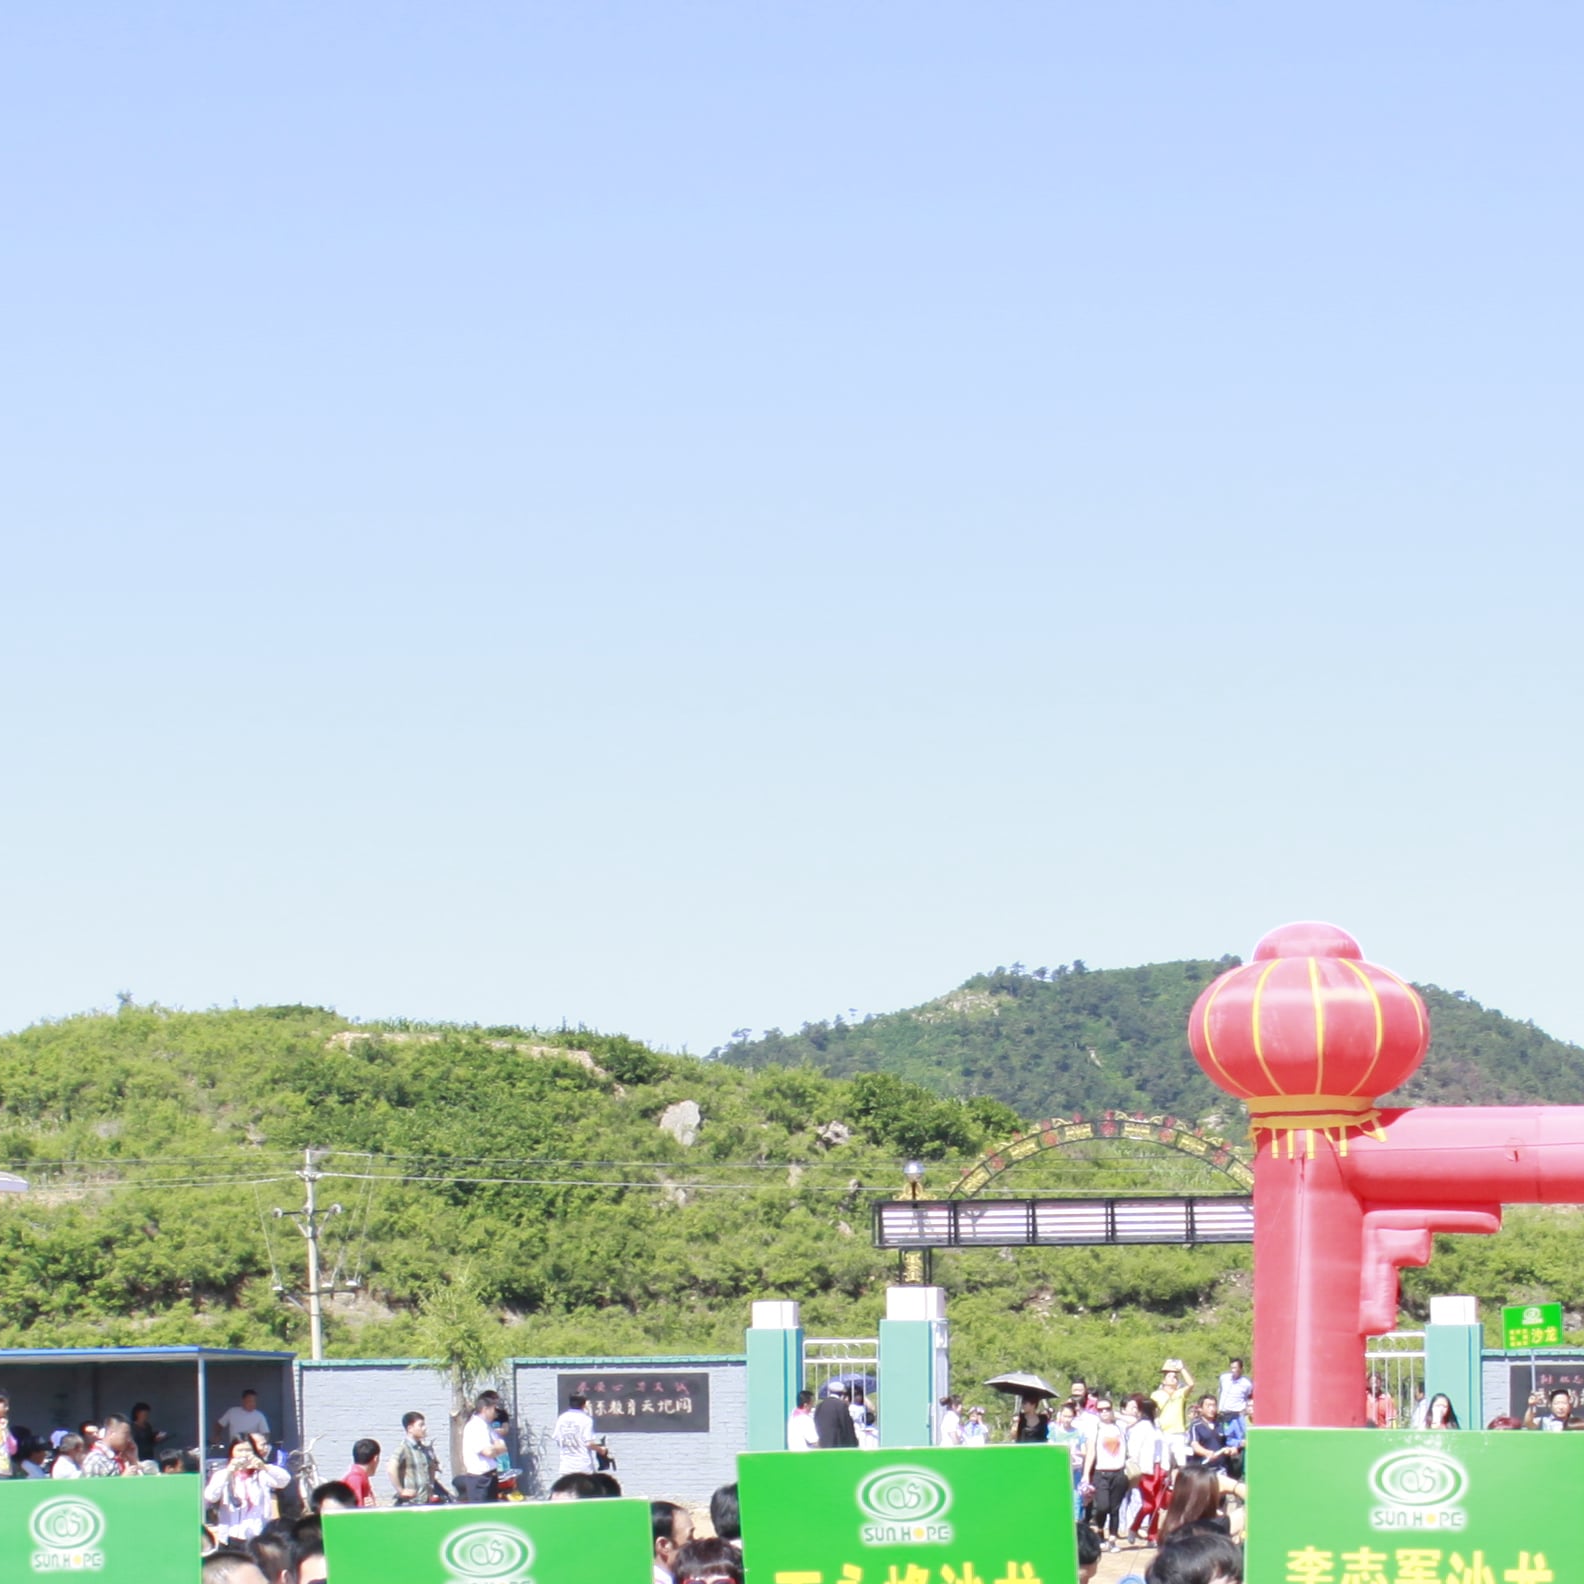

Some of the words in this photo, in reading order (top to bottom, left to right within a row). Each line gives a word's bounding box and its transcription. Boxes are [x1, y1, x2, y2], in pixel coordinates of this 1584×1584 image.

[1531, 1327, 1558, 1344] 沙龙
[1373, 1511, 1407, 1526] SUN
[1413, 1511, 1464, 1527] HOPE
[864, 1527, 896, 1542] SUN
[902, 1526, 950, 1541] HOPE
